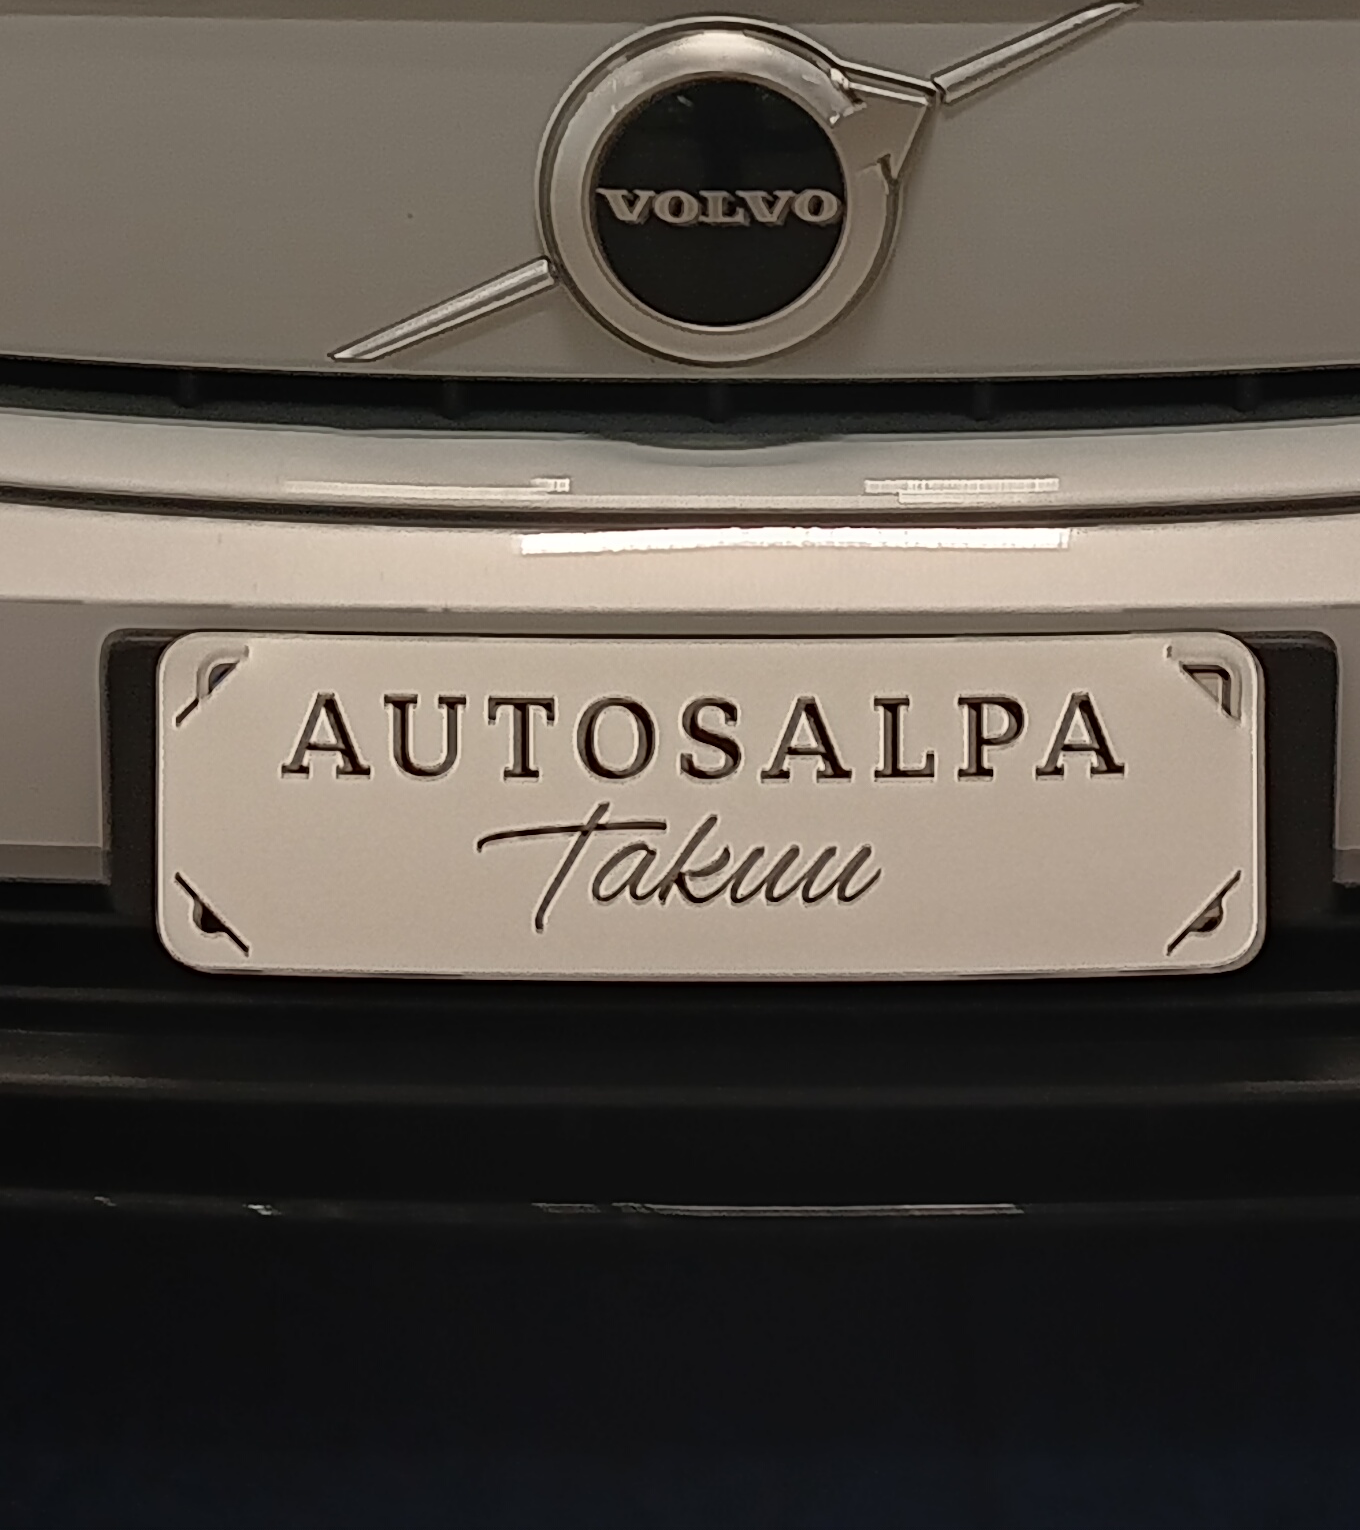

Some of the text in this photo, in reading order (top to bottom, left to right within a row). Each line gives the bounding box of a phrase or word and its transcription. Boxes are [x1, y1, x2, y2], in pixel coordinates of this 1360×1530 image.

[596, 188, 841, 225] VOLVO
[281, 692, 1126, 781] AUTOSALPA
[476, 801, 882, 934] Takuu
